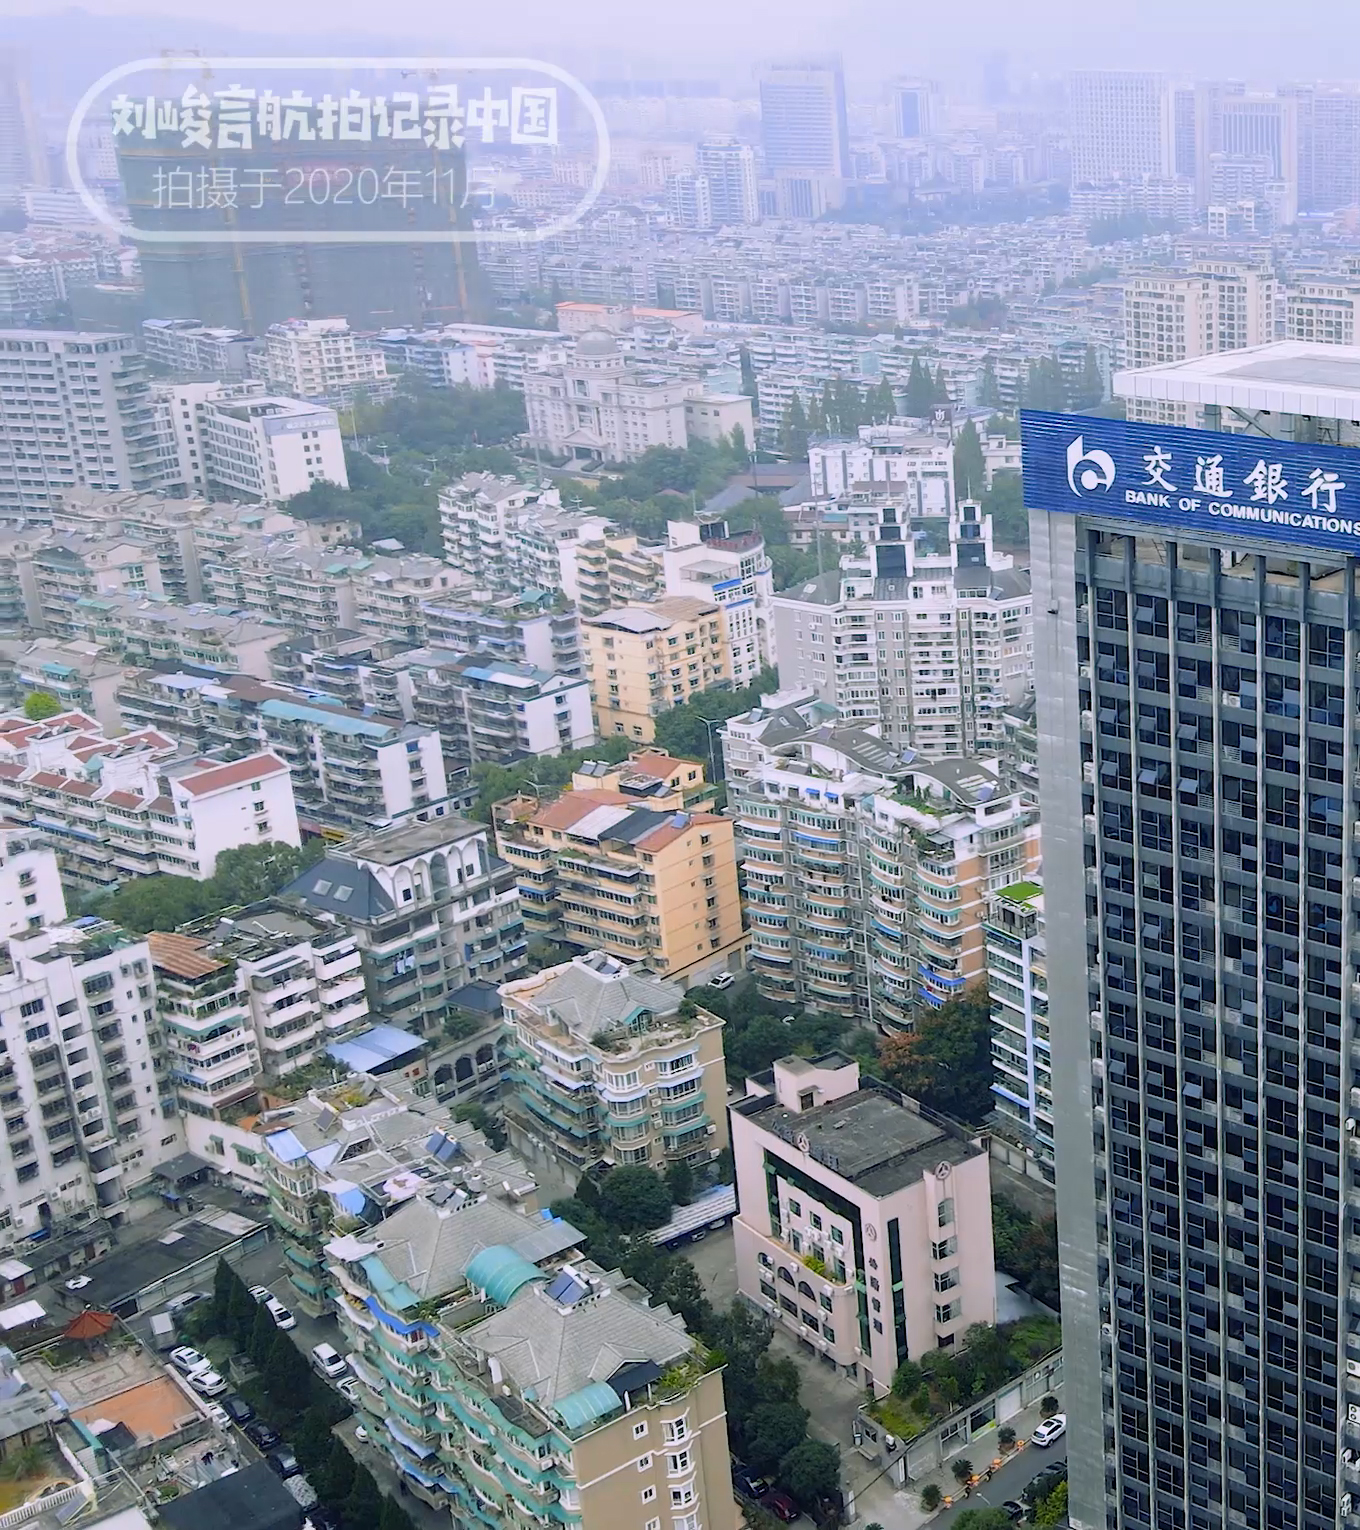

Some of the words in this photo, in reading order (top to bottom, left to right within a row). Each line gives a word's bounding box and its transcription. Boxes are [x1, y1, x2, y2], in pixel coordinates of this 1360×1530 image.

[1125, 490, 1171, 509] BANK
[1178, 496, 1201, 513] OF
[1141, 445, 1346, 514] 交通銀行
